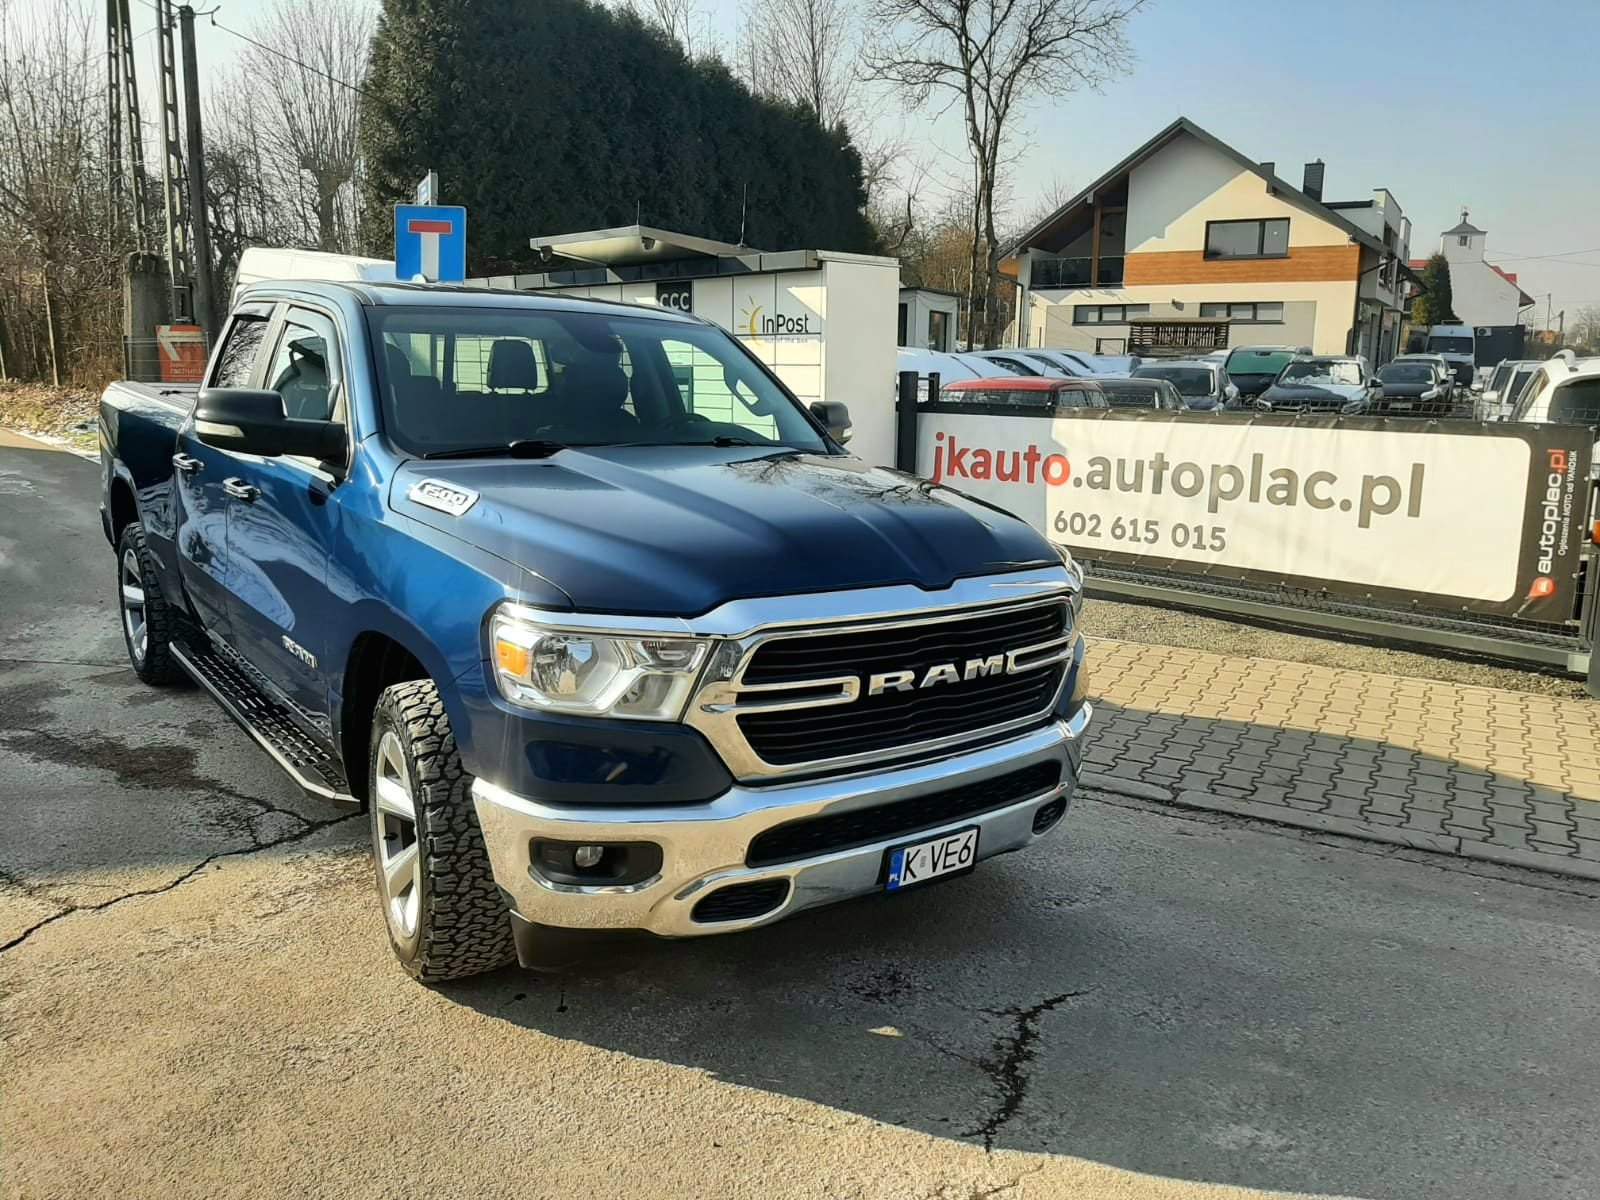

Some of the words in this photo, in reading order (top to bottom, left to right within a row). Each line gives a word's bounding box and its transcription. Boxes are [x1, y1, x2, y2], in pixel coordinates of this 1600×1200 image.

[659, 292, 690, 310] CCC
[762, 313, 809, 333] InPost
[932, 431, 1425, 529] jkauto.autoplac.pl
[1566, 482, 1574, 494] od
[1537, 449, 1568, 575] autoplac.pl
[1562, 493, 1573, 517] MOTO
[1054, 510, 1103, 538] 602
[1110, 516, 1160, 544] 615
[1171, 522, 1226, 552] 015
[282, 635, 318, 668] RAM
[868, 654, 1004, 696] RAM
[903, 848, 923, 882] K
[931, 834, 974, 873] VE6
[889, 873, 900, 883] PL
